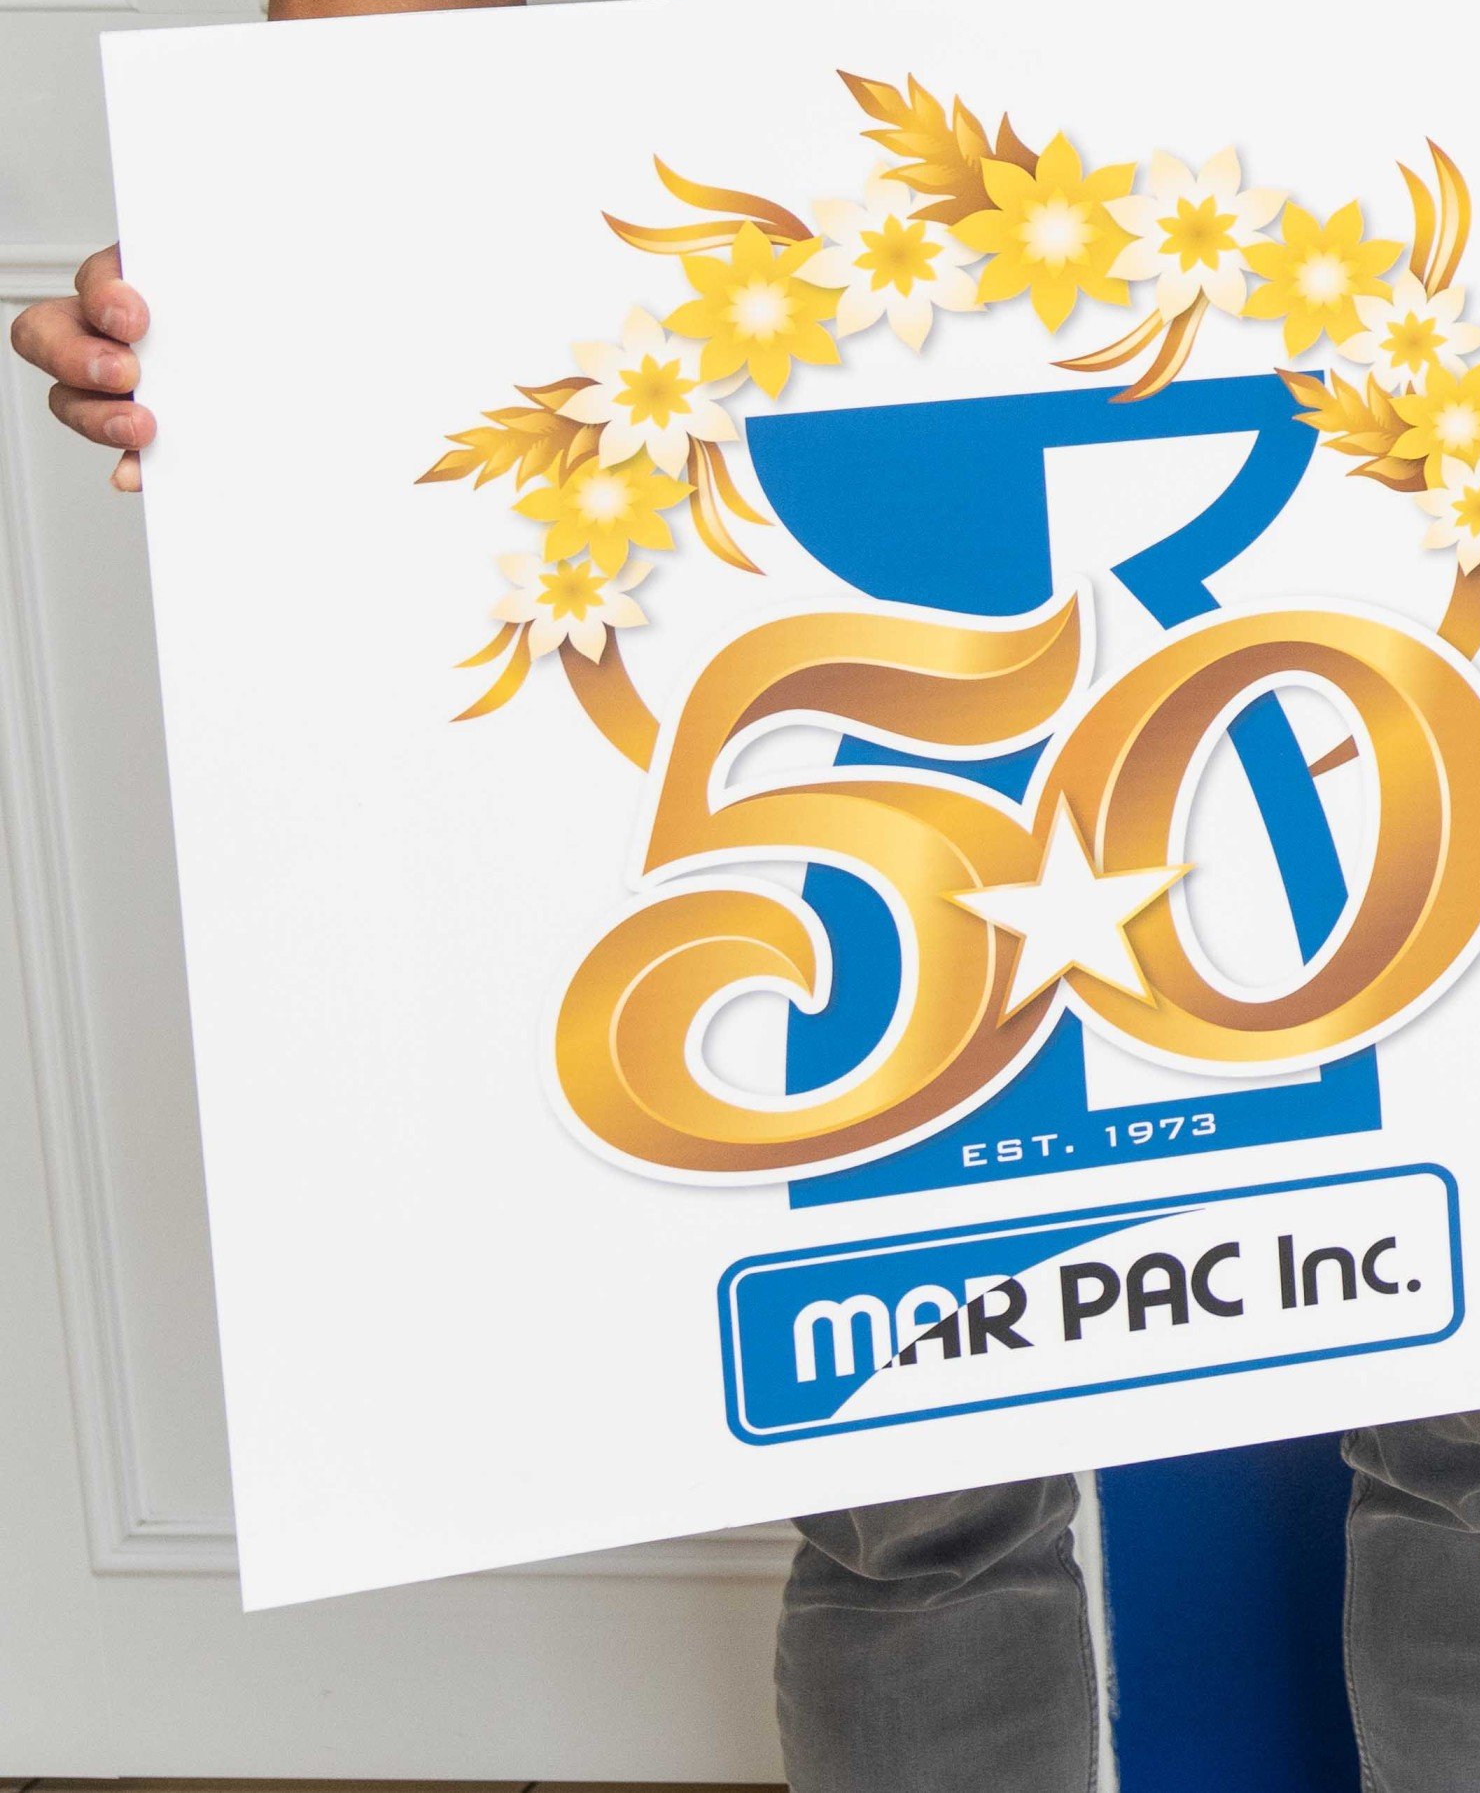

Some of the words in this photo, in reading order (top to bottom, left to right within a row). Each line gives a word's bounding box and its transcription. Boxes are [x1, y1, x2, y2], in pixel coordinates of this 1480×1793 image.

[960, 1131, 1076, 1170] EST.
[1104, 1111, 1219, 1150] 1973
[1058, 1240, 1245, 1342] PAC
[1277, 1233, 1422, 1310] Inc.
